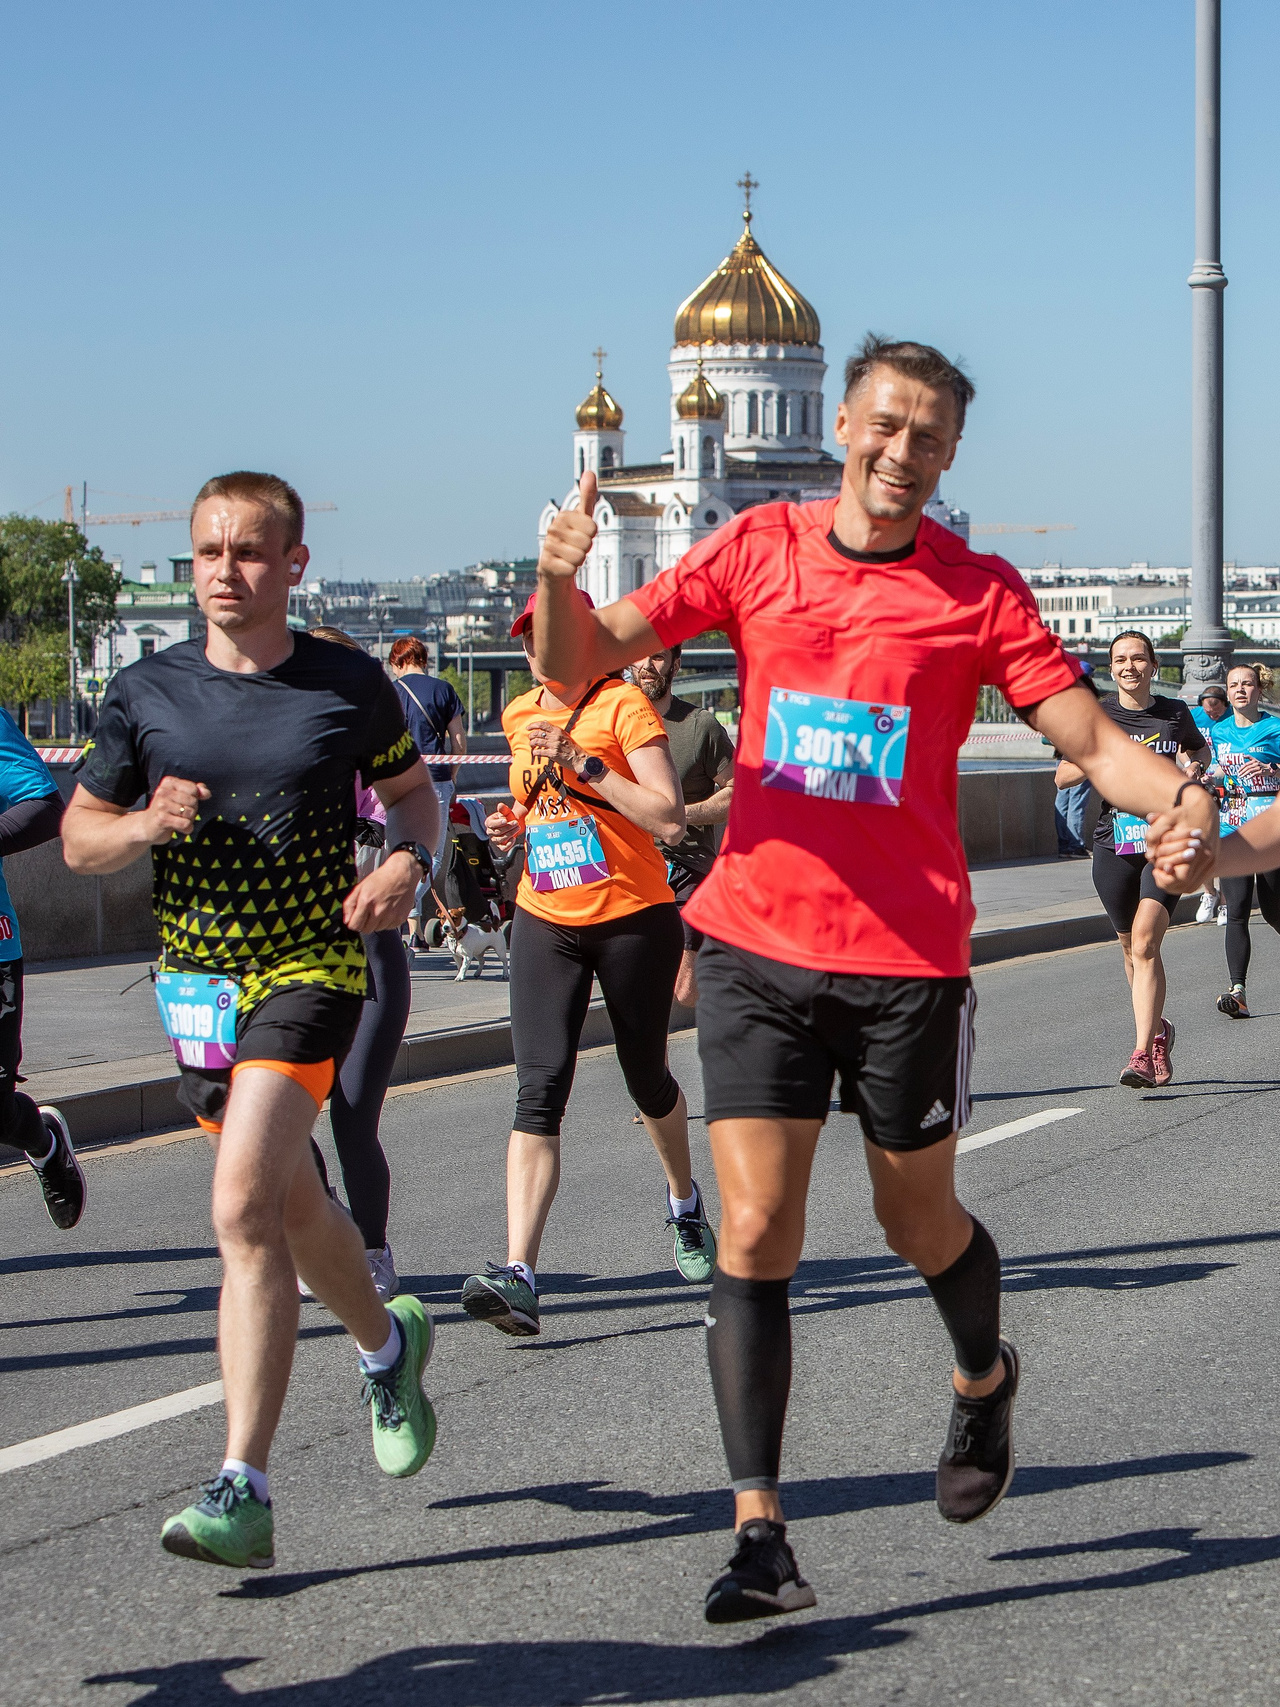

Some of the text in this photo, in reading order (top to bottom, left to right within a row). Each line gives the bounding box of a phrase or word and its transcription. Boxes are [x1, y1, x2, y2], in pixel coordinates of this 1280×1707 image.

[794, 725, 873, 770] 30114
[1146, 740, 1177, 754] CLUB
[803, 766, 858, 802] 10KM
[1125, 824, 1151, 841] 360
[535, 839, 587, 869] 33435
[548, 866, 583, 890] 10KM
[167, 1001, 213, 1038] 31019
